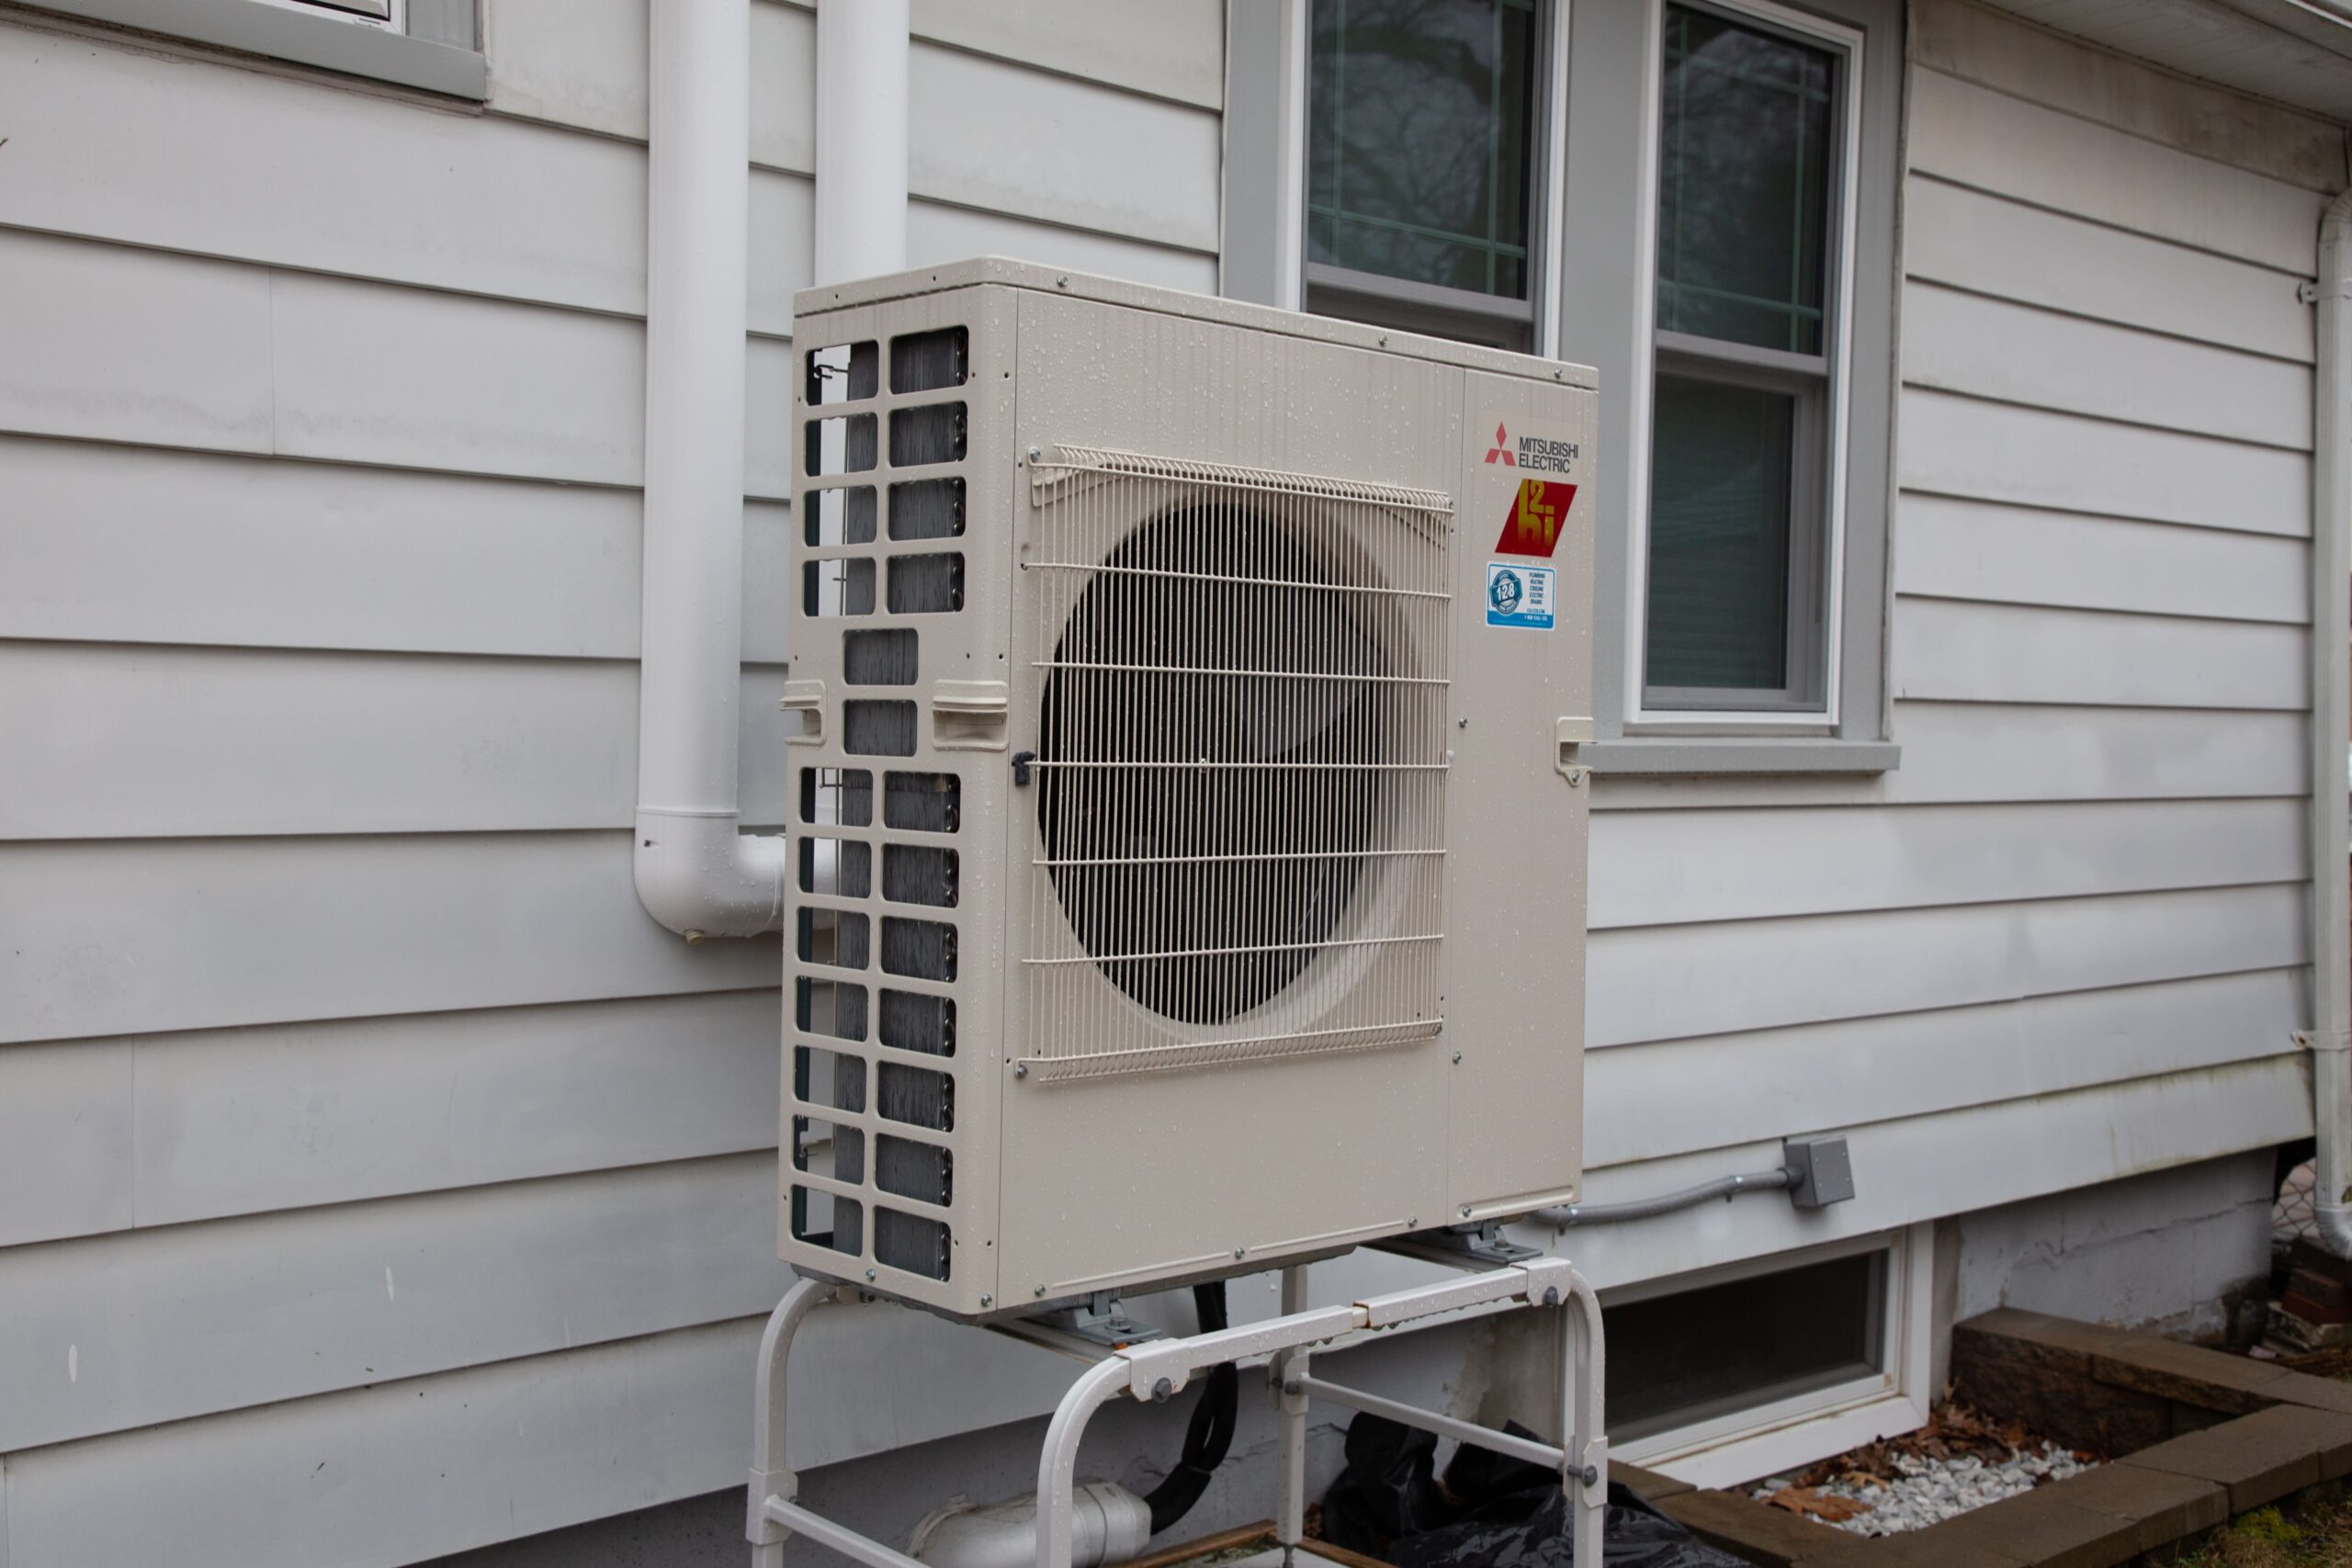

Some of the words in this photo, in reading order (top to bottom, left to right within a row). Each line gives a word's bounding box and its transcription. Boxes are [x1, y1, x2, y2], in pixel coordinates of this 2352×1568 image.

[1520, 436, 1578, 458] MITSUBISHI
[1519, 453, 1570, 473] ELECTRIC
[1497, 583, 1515, 601] 128
